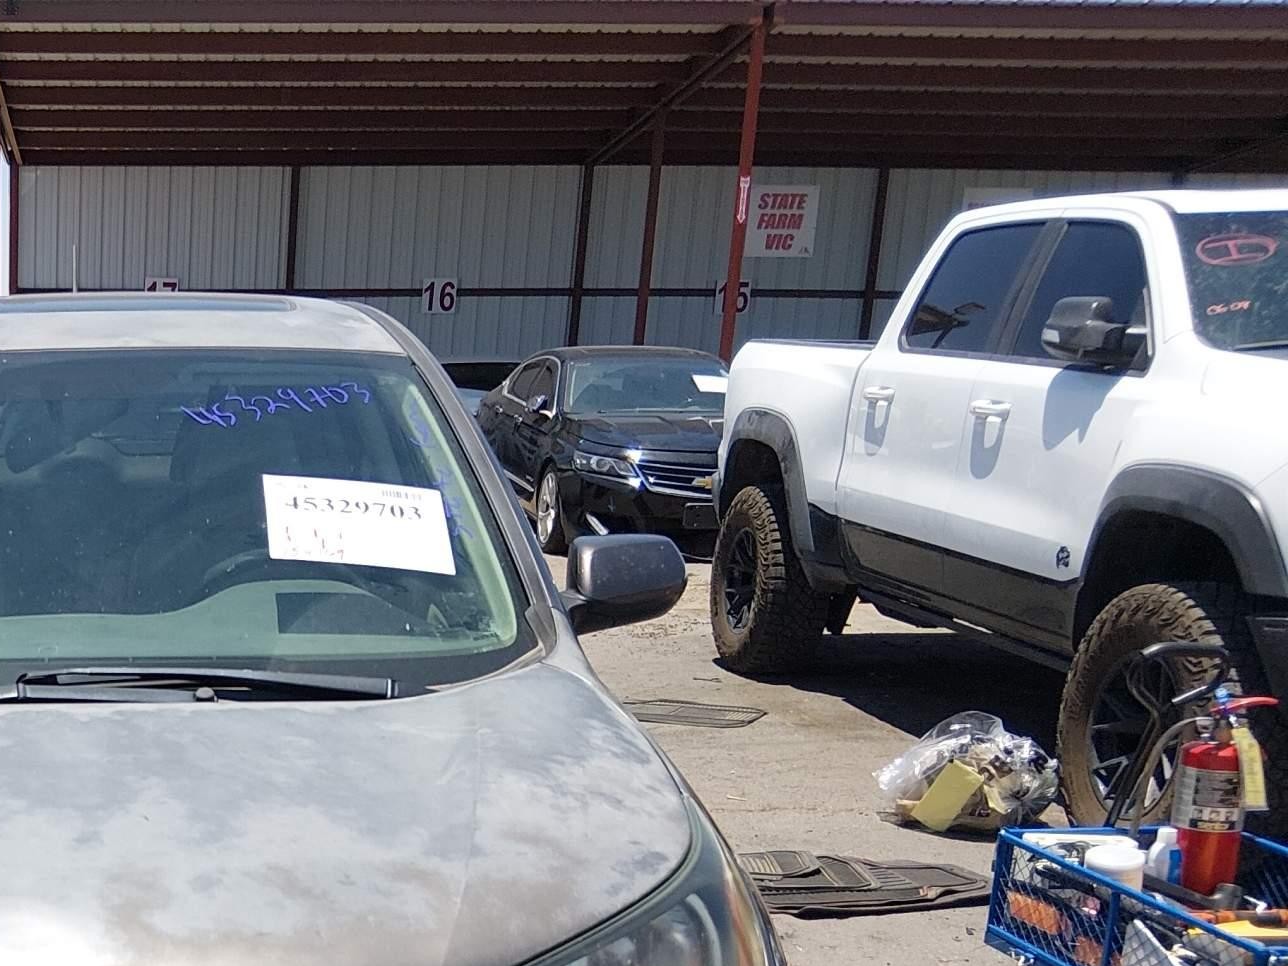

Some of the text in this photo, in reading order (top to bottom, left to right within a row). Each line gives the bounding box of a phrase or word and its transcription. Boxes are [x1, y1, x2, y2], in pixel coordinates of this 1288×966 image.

[758, 193, 809, 210] STATE
[757, 213, 804, 230] FARM
[764, 233, 795, 250] VIC
[424, 281, 455, 312] 16
[718, 281, 749, 313] 15
[180, 382, 370, 428] 45329703
[285, 496, 423, 520] 45329703
